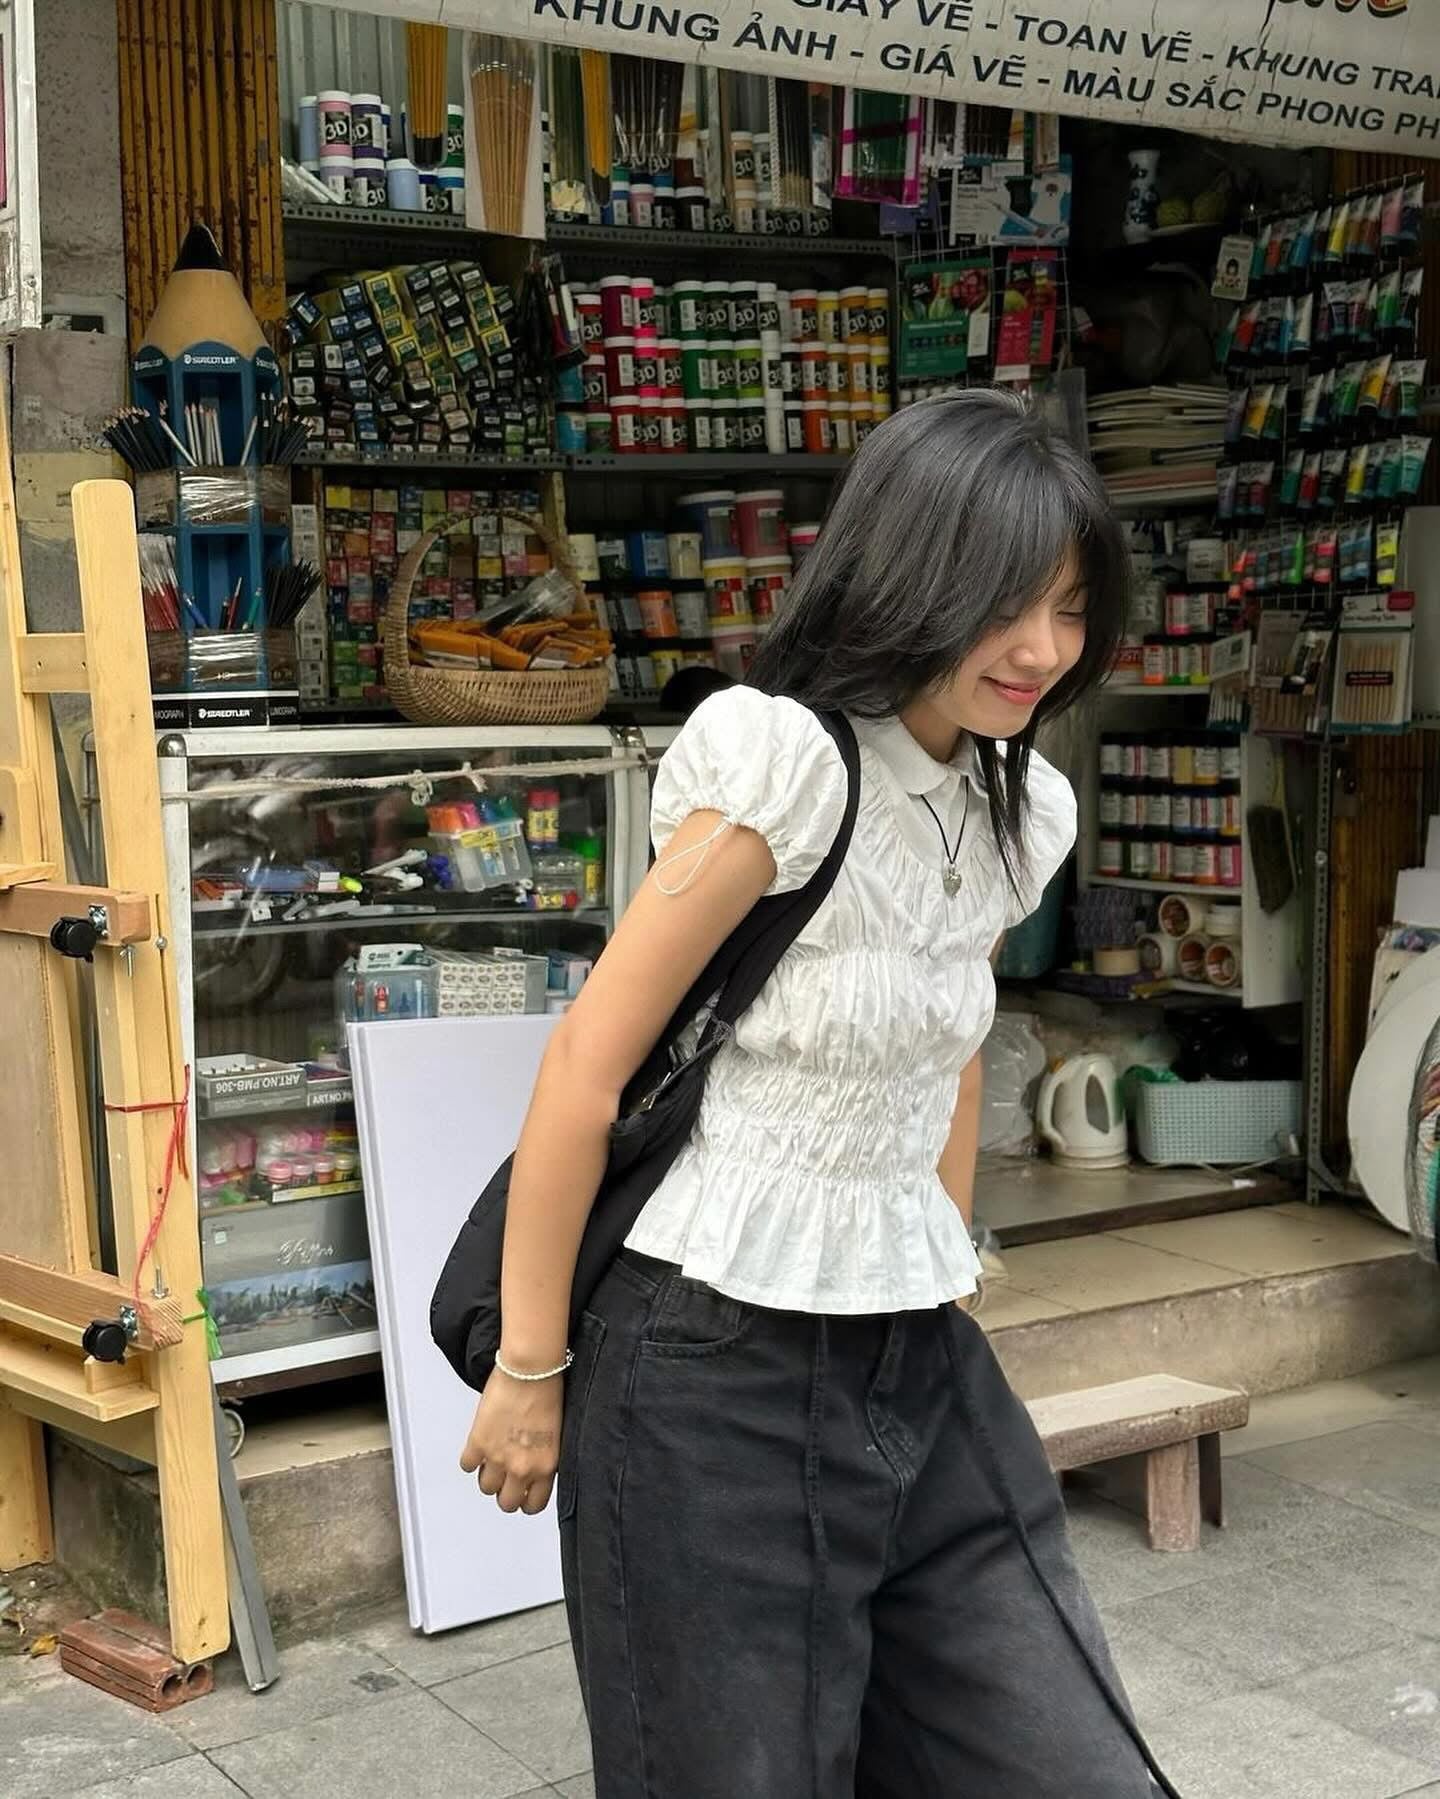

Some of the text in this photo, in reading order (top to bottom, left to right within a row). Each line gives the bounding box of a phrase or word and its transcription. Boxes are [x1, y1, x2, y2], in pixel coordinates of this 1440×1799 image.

[916, 0, 973, 32] VẼ
[1014, 14, 1127, 55] TOAN
[1140, 31, 1193, 63] VẼ
[1226, 45, 1360, 86] KHUNG
[1371, 67, 1440, 99] TRA
[534, 0, 719, 42] KHUNG
[733, 12, 838, 61] ẢNH
[880, 44, 956, 78] GIÁ
[972, 54, 1027, 88] VẼ
[1063, 66, 1156, 102] MÀU
[1165, 75, 1247, 112] SẮC
[1256, 92, 1386, 132] PHONG
[326, 120, 348, 141] 3D
[811, 217, 830, 237] 3D
[706, 308, 728, 327] 3D
[736, 308, 756, 327] 3D
[760, 309, 778, 328] 3D
[740, 366, 760, 385] 3D
[743, 424, 763, 442] 3D
[215, 1080, 261, 1094] PMB-306
